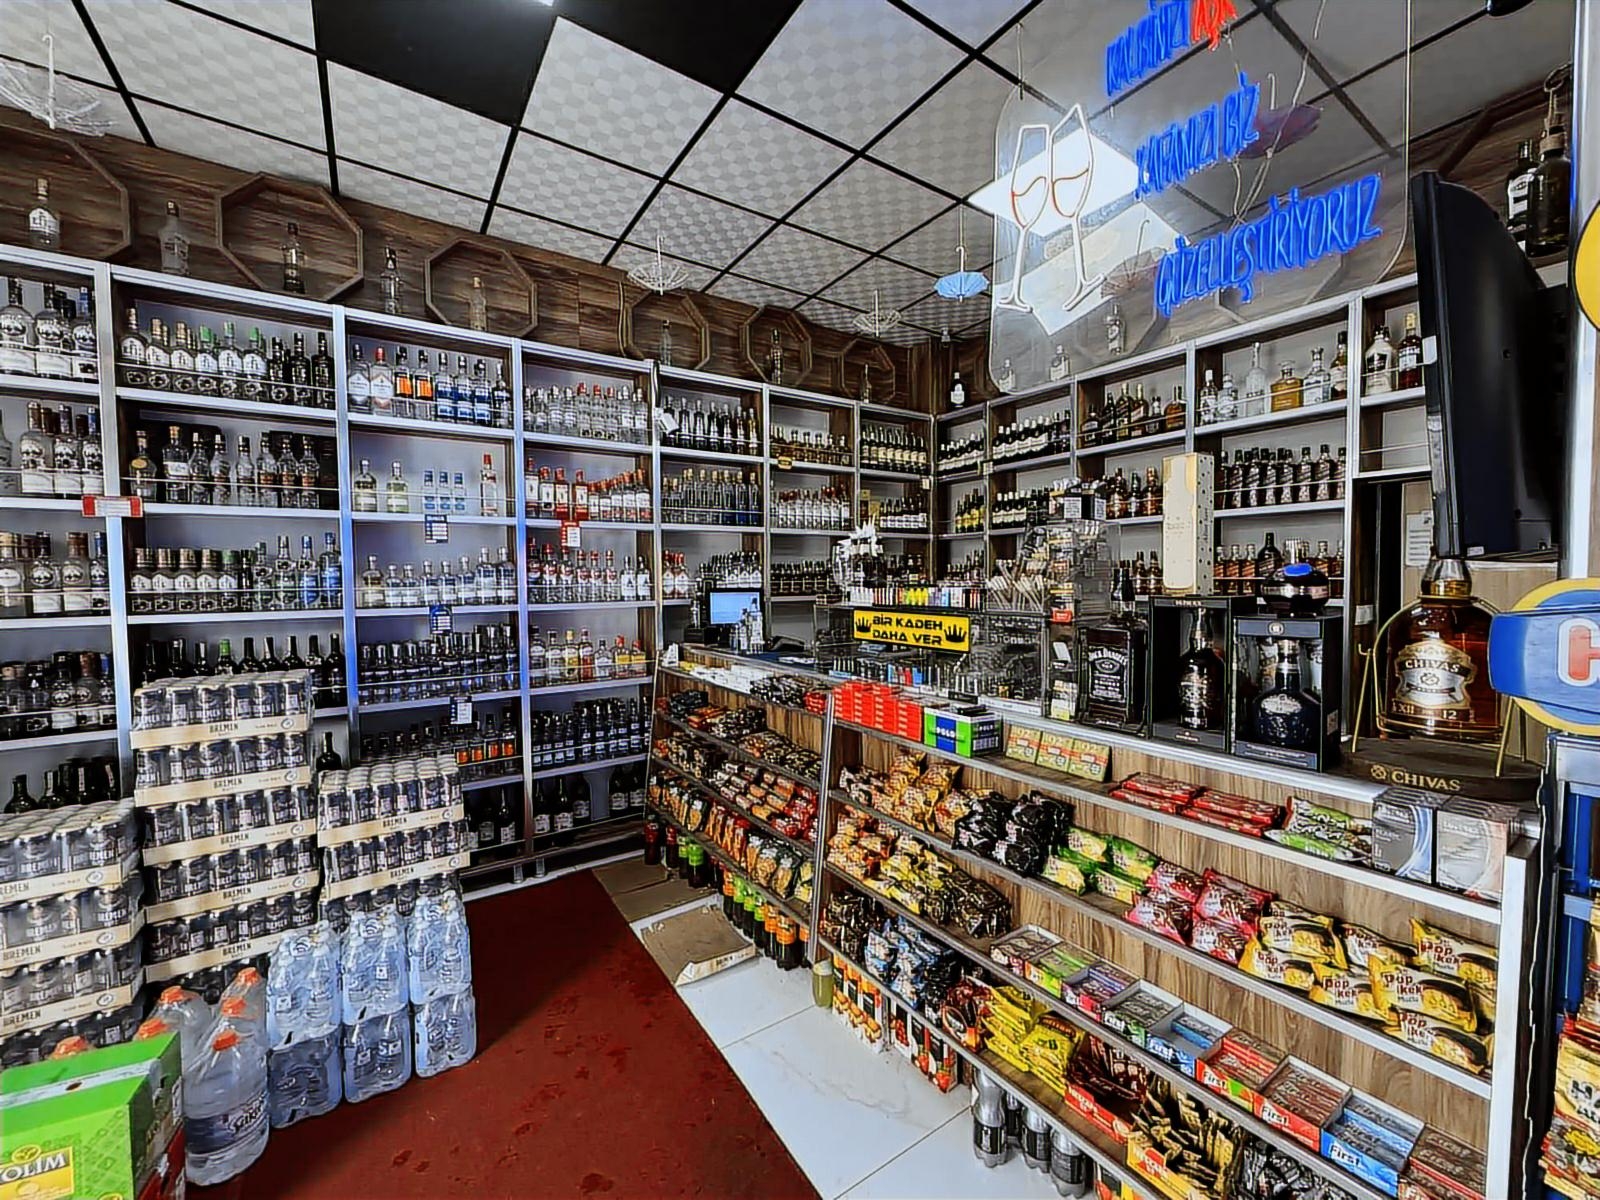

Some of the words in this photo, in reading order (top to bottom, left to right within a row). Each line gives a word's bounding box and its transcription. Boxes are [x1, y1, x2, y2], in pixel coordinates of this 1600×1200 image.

[872, 614, 893, 626] BİR
[896, 617, 943, 631] KADEH
[872, 629, 908, 642] DAHA
[912, 633, 943, 646] VER
[1405, 659, 1460, 672] CHIVAS
[1443, 710, 1457, 720] 12
[1391, 771, 1461, 791] CHIVAS
[1262, 1104, 1289, 1126] First
[1329, 1143, 1361, 1166] First
